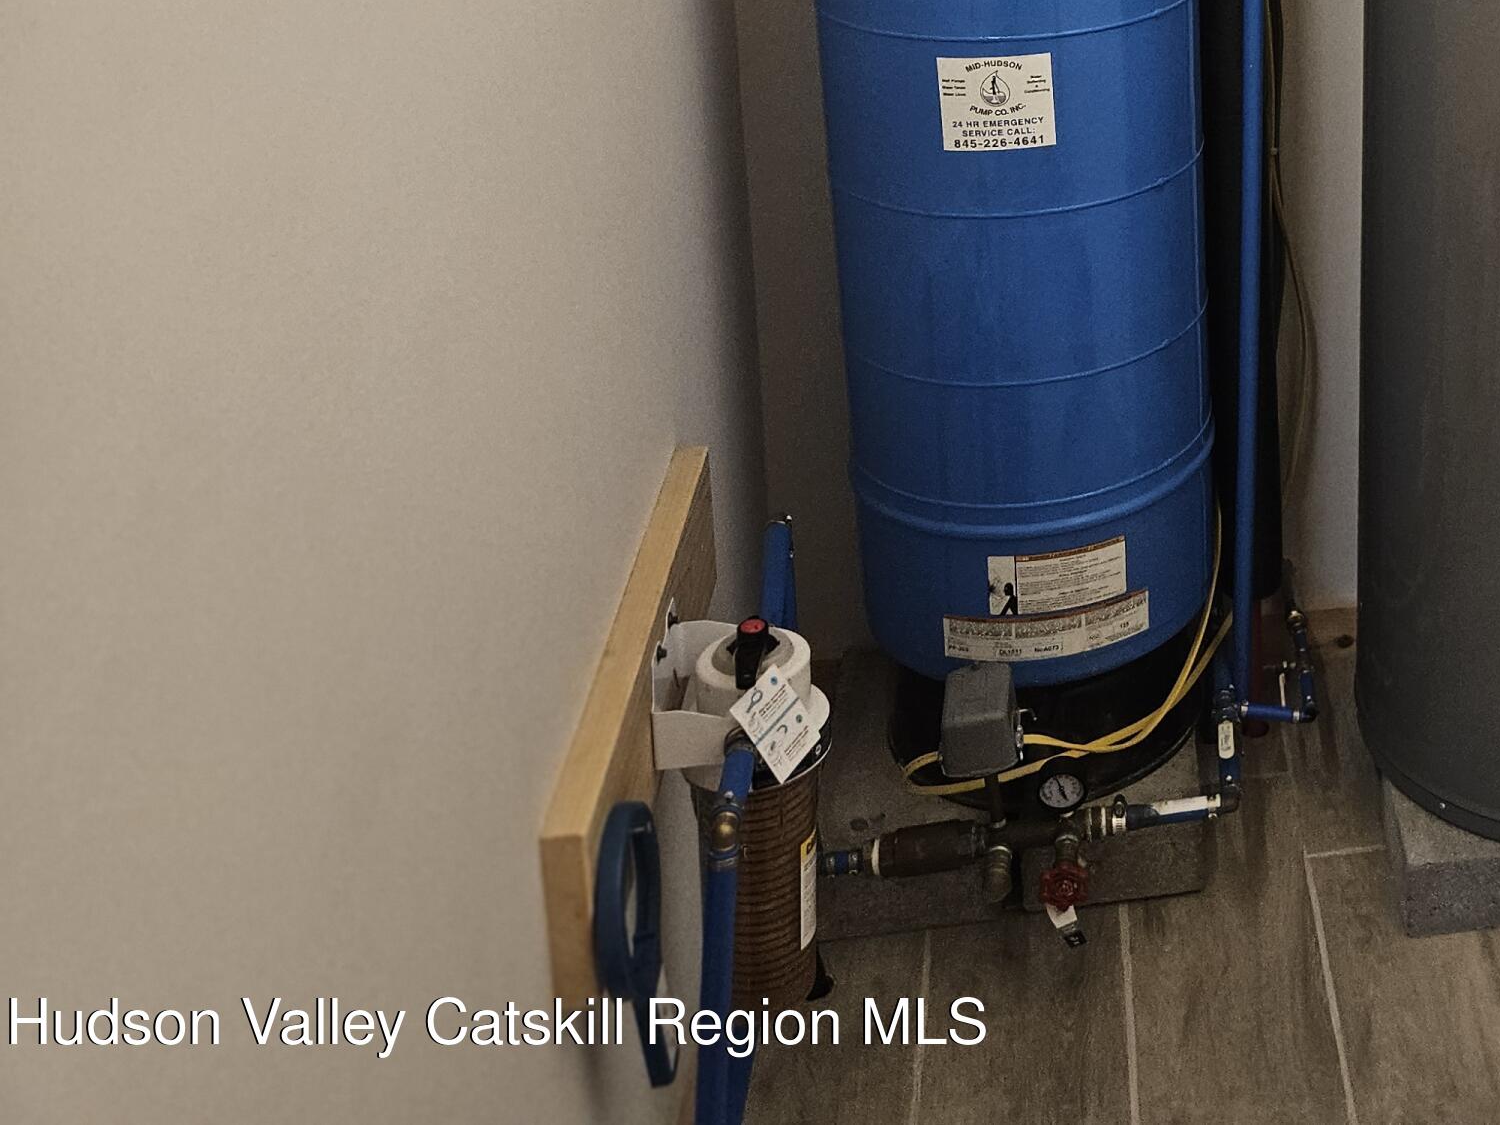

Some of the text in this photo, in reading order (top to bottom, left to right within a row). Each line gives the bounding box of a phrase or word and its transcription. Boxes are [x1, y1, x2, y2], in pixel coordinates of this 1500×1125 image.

[965, 60, 1023, 73] MID-HUDSON
[969, 105, 993, 116] PUMP
[966, 120, 980, 128] HR
[983, 116, 1045, 128] EMERGENCY
[962, 128, 1004, 138] SERVICE
[954, 134, 1045, 149] 845-226-4641
